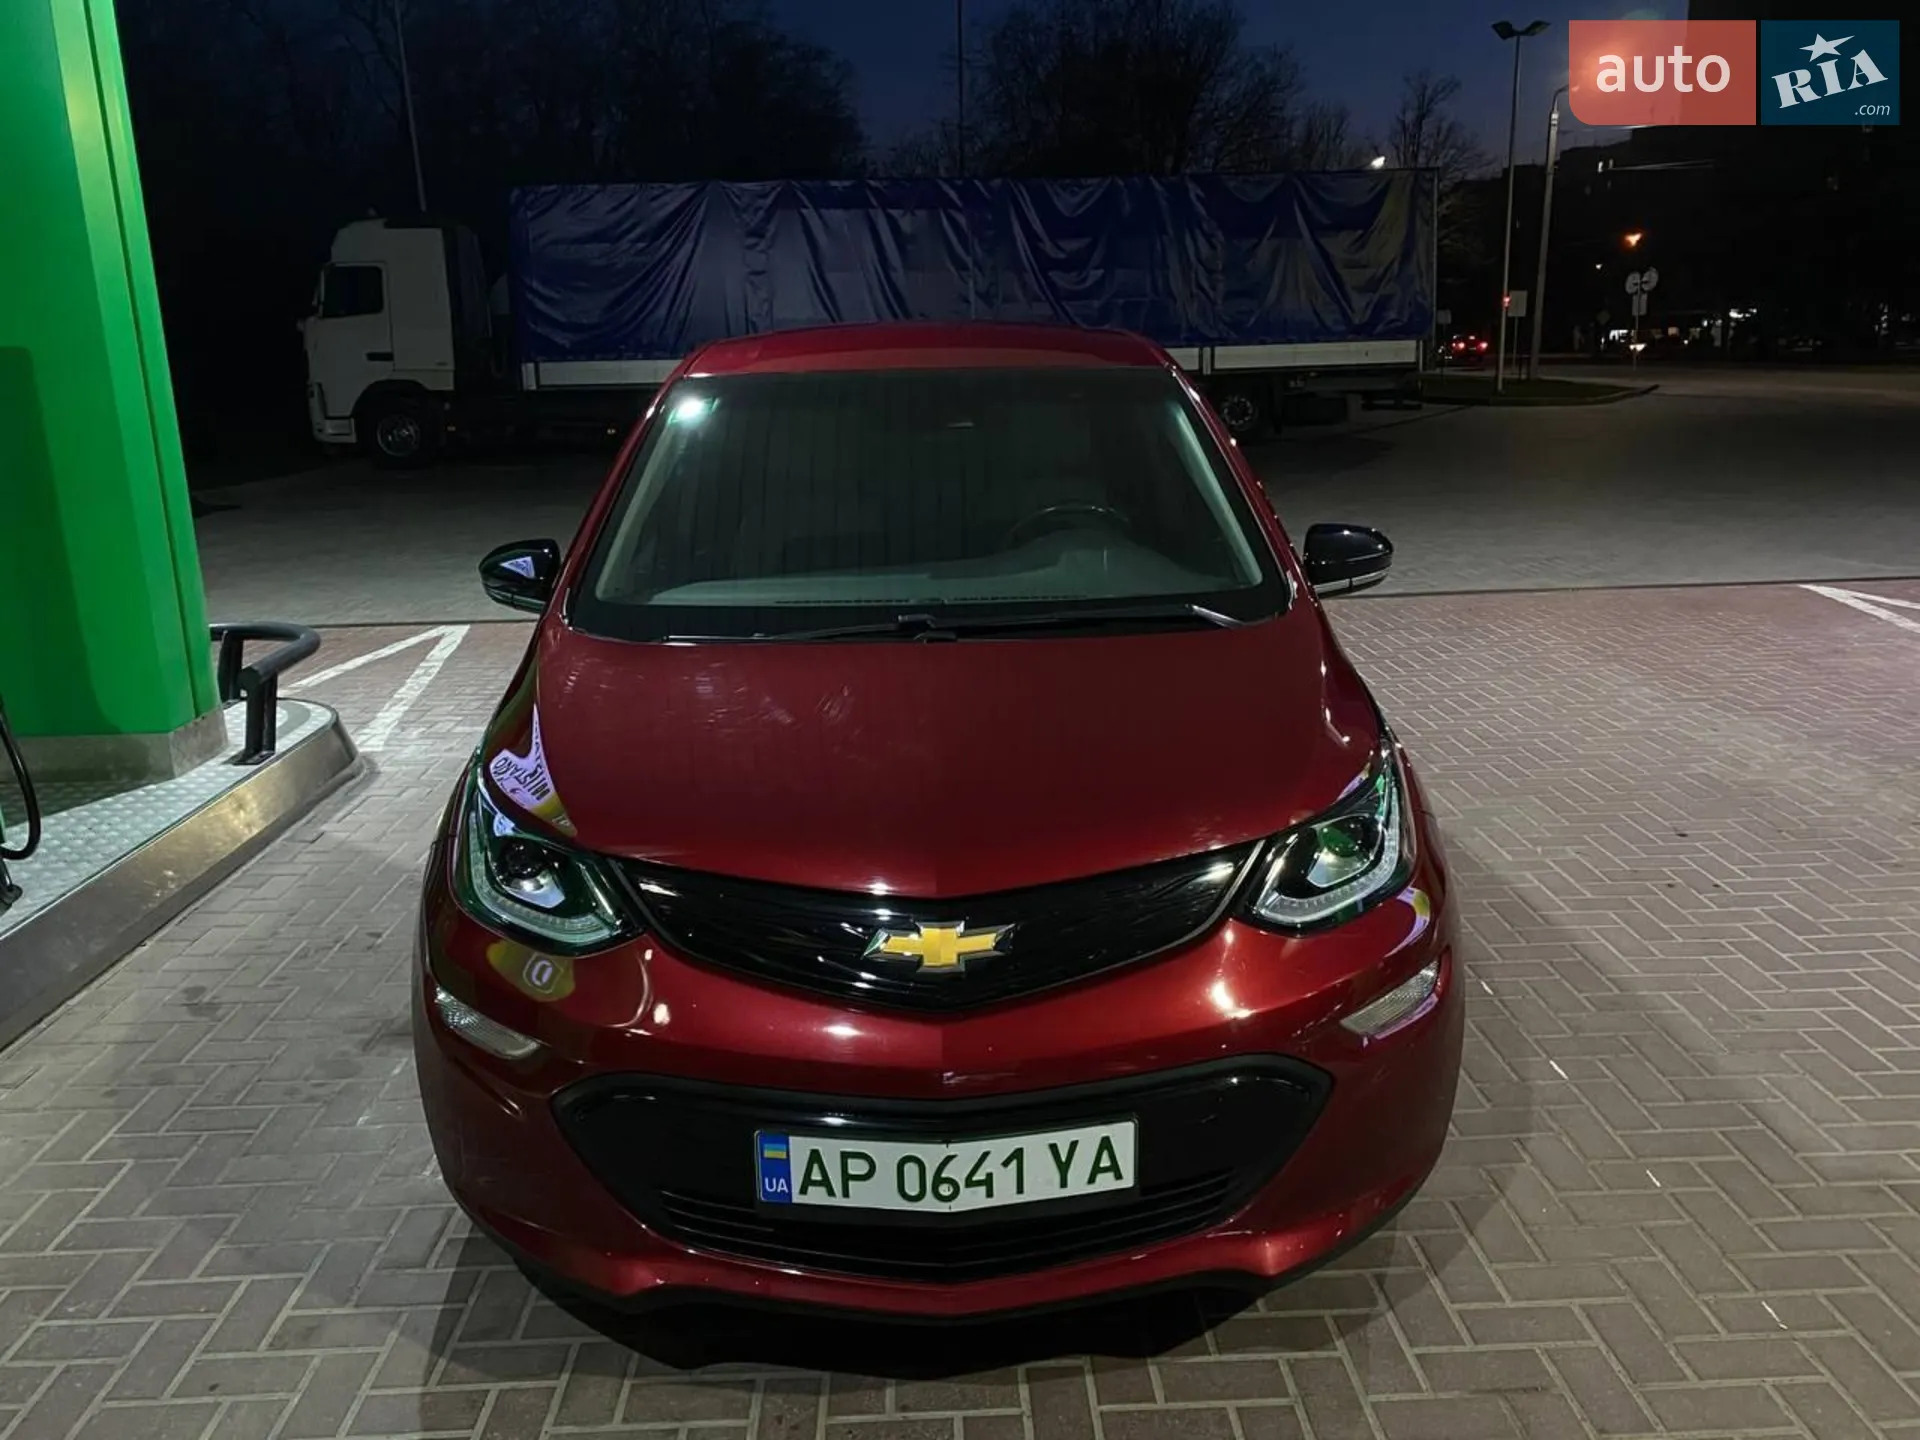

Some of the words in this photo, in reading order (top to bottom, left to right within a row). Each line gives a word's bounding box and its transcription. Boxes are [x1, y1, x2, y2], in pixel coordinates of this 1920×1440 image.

[765, 1176, 789, 1193] UA
[799, 1148, 877, 1199] AP
[896, 1146, 1025, 1203] 0641
[1048, 1135, 1124, 1189] YA
